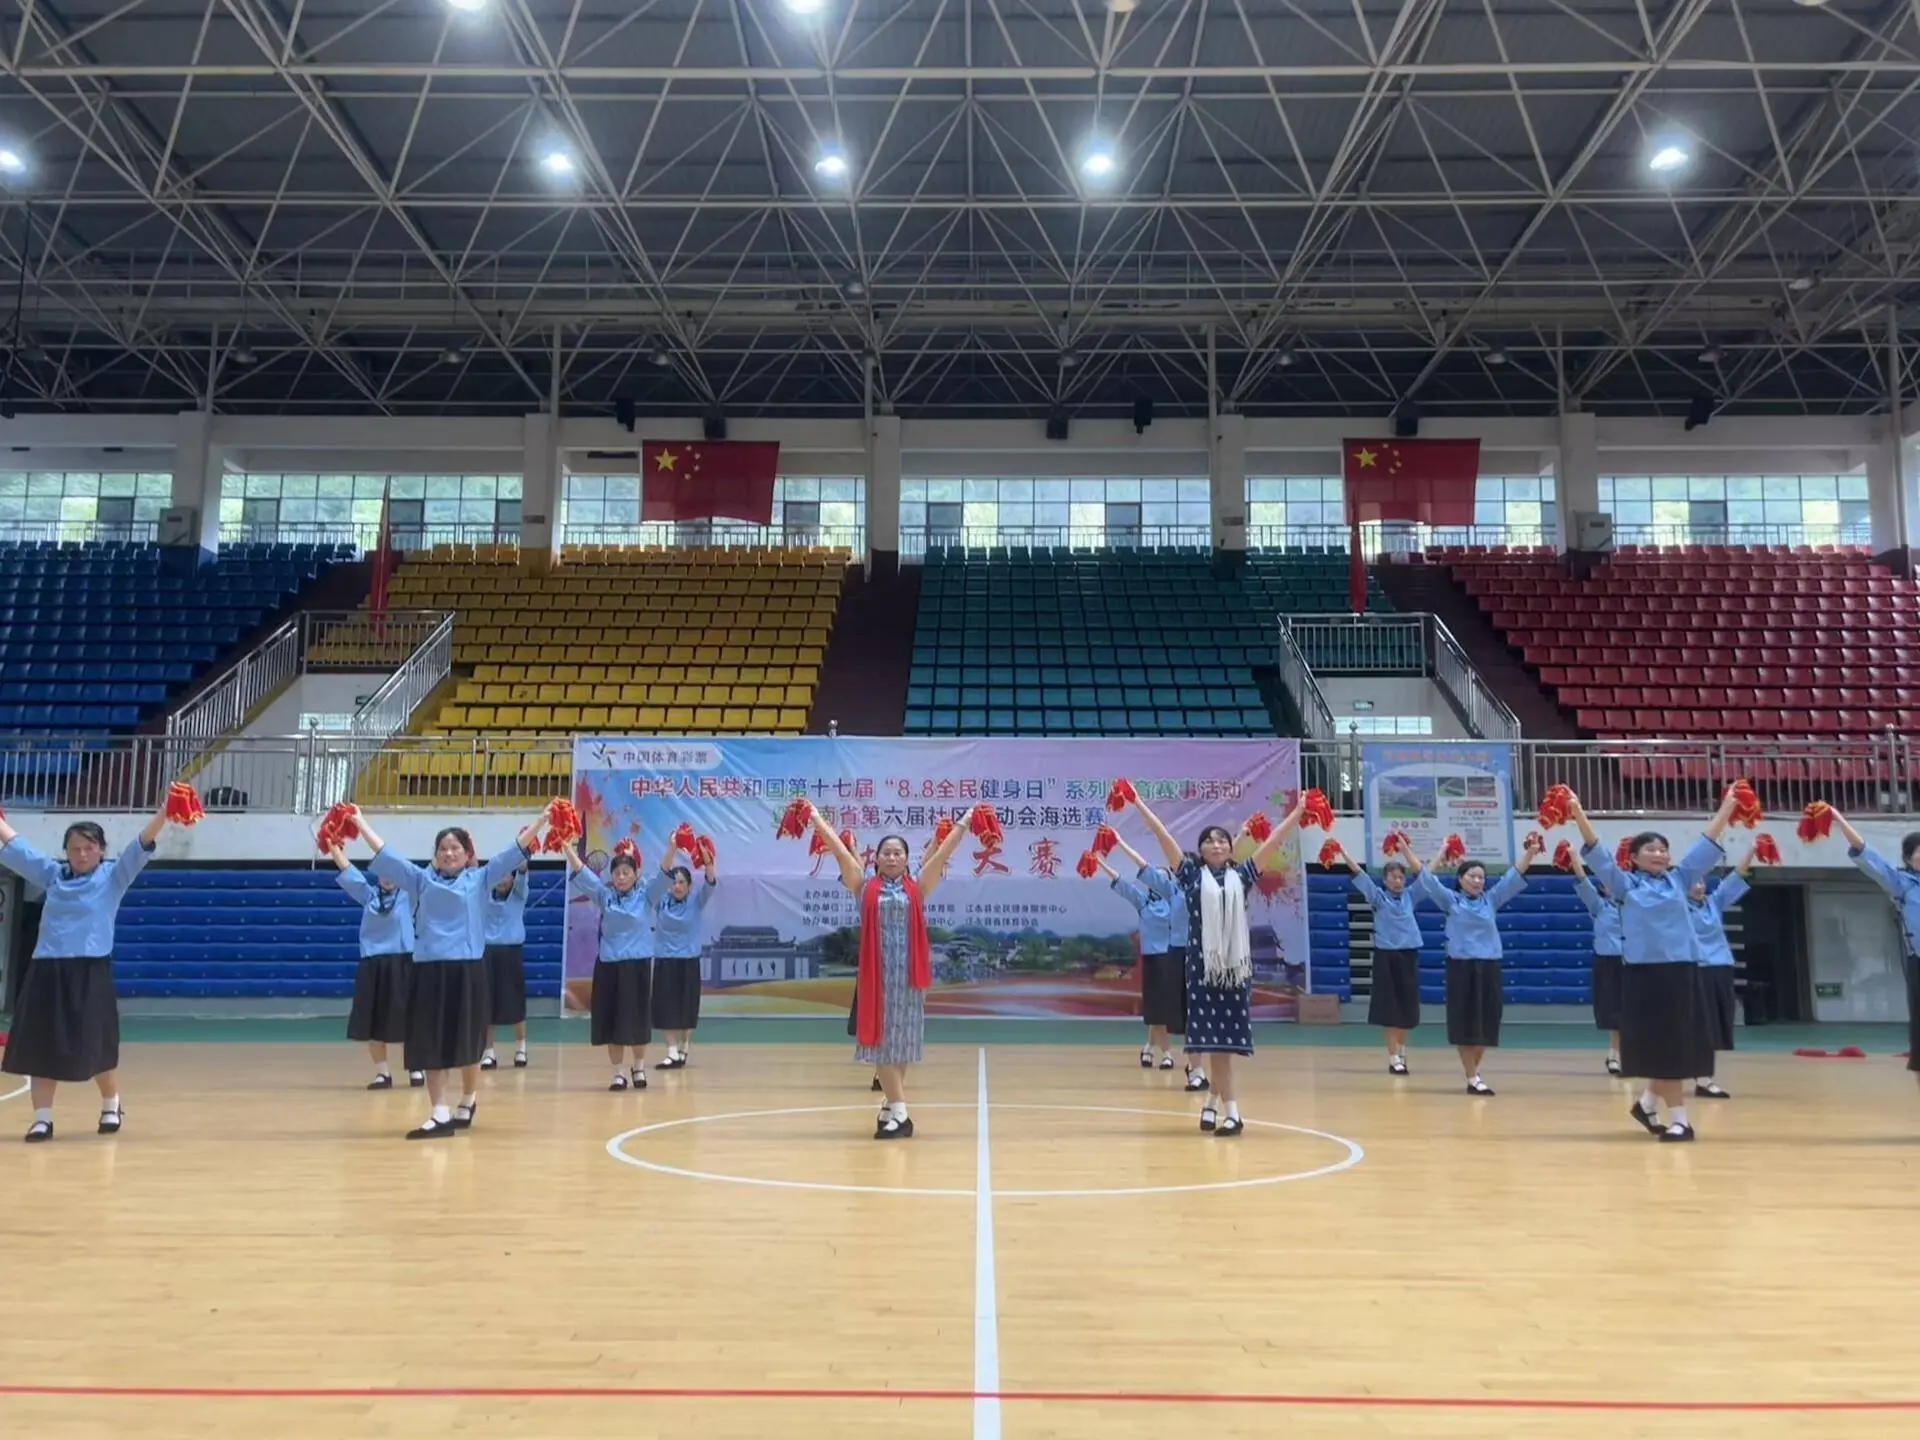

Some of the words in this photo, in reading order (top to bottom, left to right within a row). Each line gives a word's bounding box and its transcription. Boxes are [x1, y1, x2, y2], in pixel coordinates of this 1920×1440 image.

[631, 777, 1243, 801] 中华人民共和国第十七届“8.8全民健身日”系列育赛事活动
[772, 804, 1105, 827] 南省第六届社区动会海选赛
